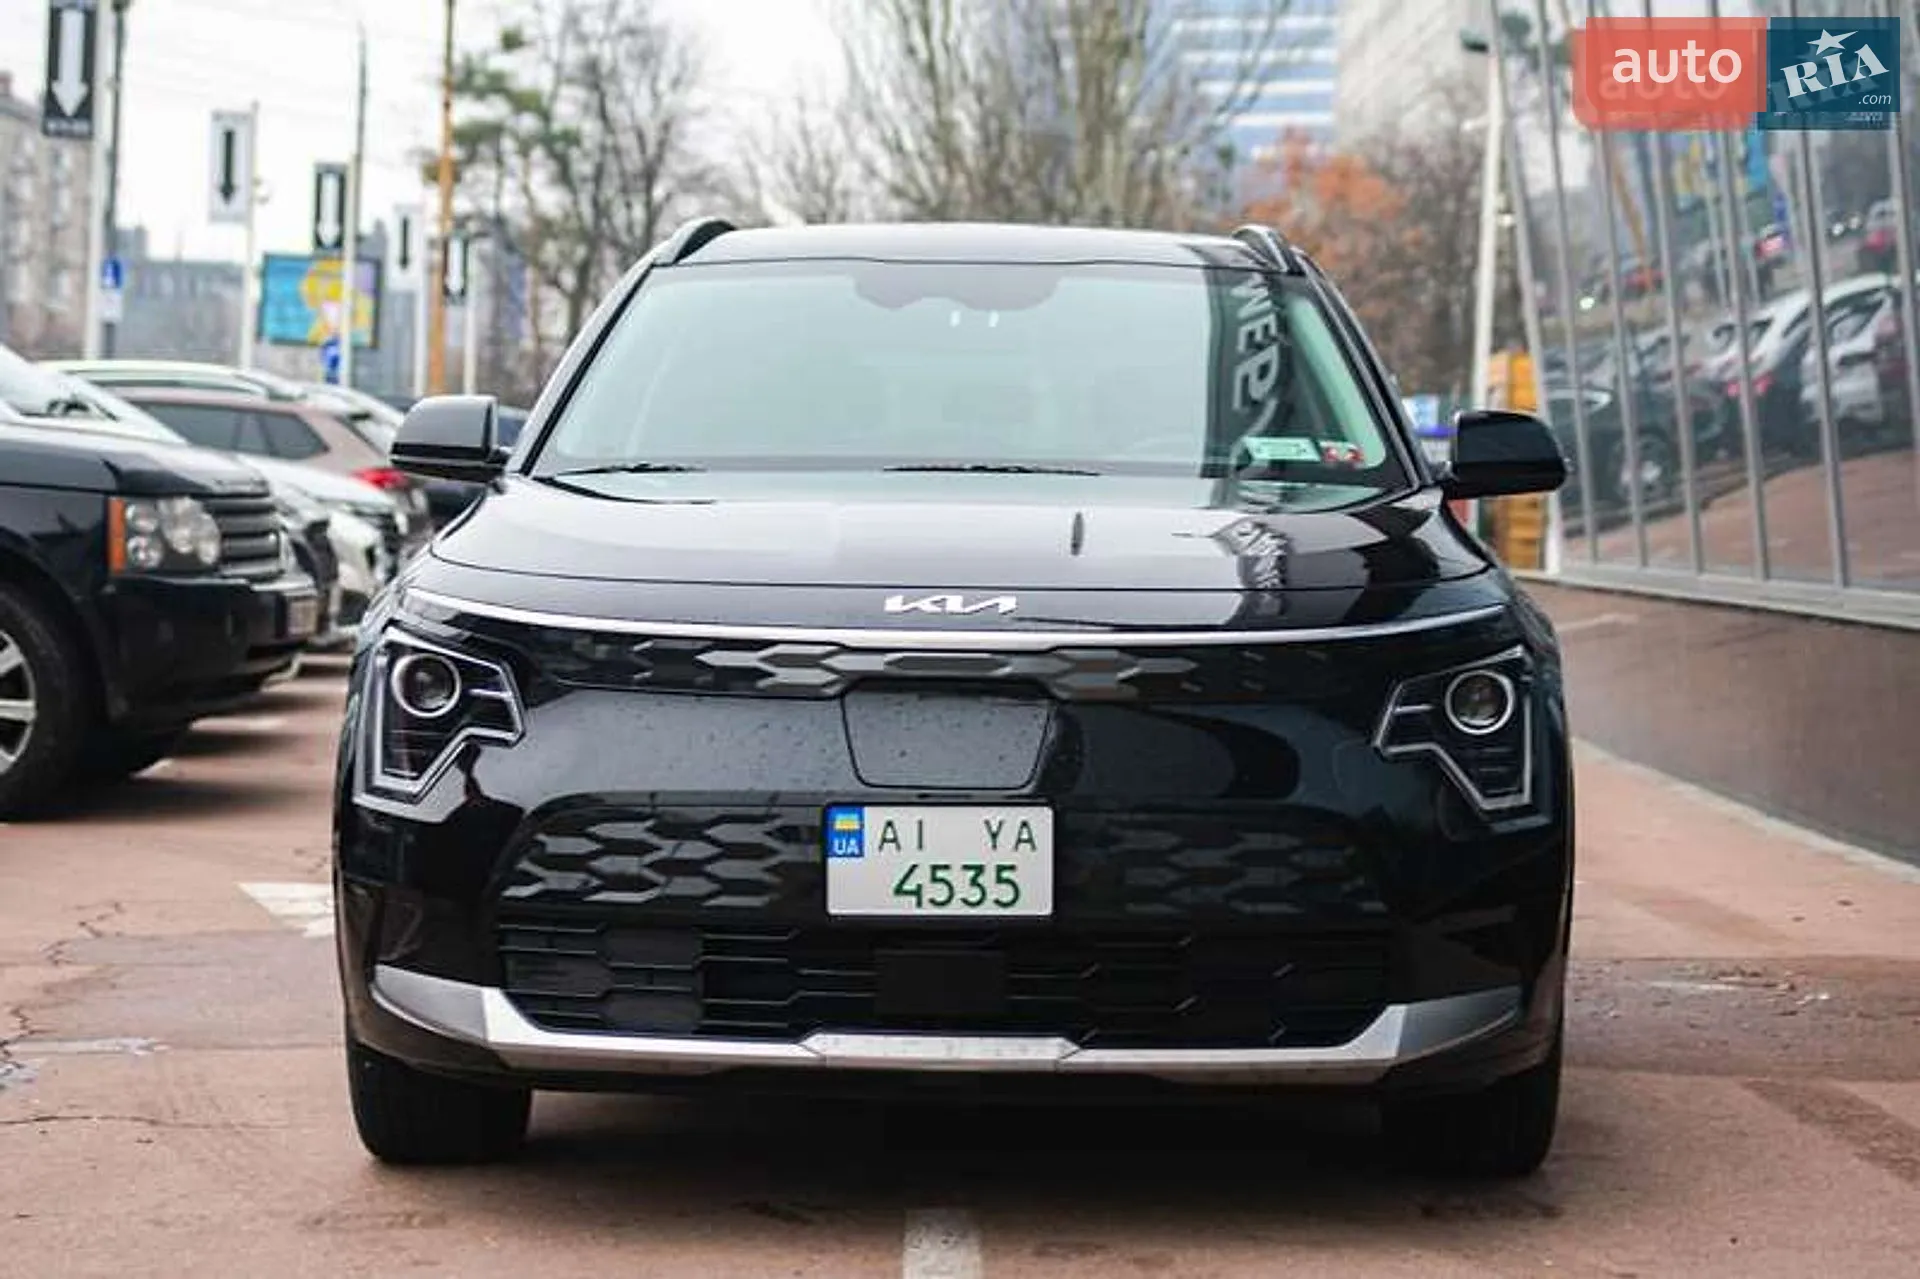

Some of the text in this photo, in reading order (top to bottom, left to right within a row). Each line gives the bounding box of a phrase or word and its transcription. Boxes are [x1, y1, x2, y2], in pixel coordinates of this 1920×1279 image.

[883, 594, 1018, 615] KIA
[833, 838, 860, 855] UA
[878, 819, 1038, 852] AI YA
[892, 863, 1021, 909] 4535
